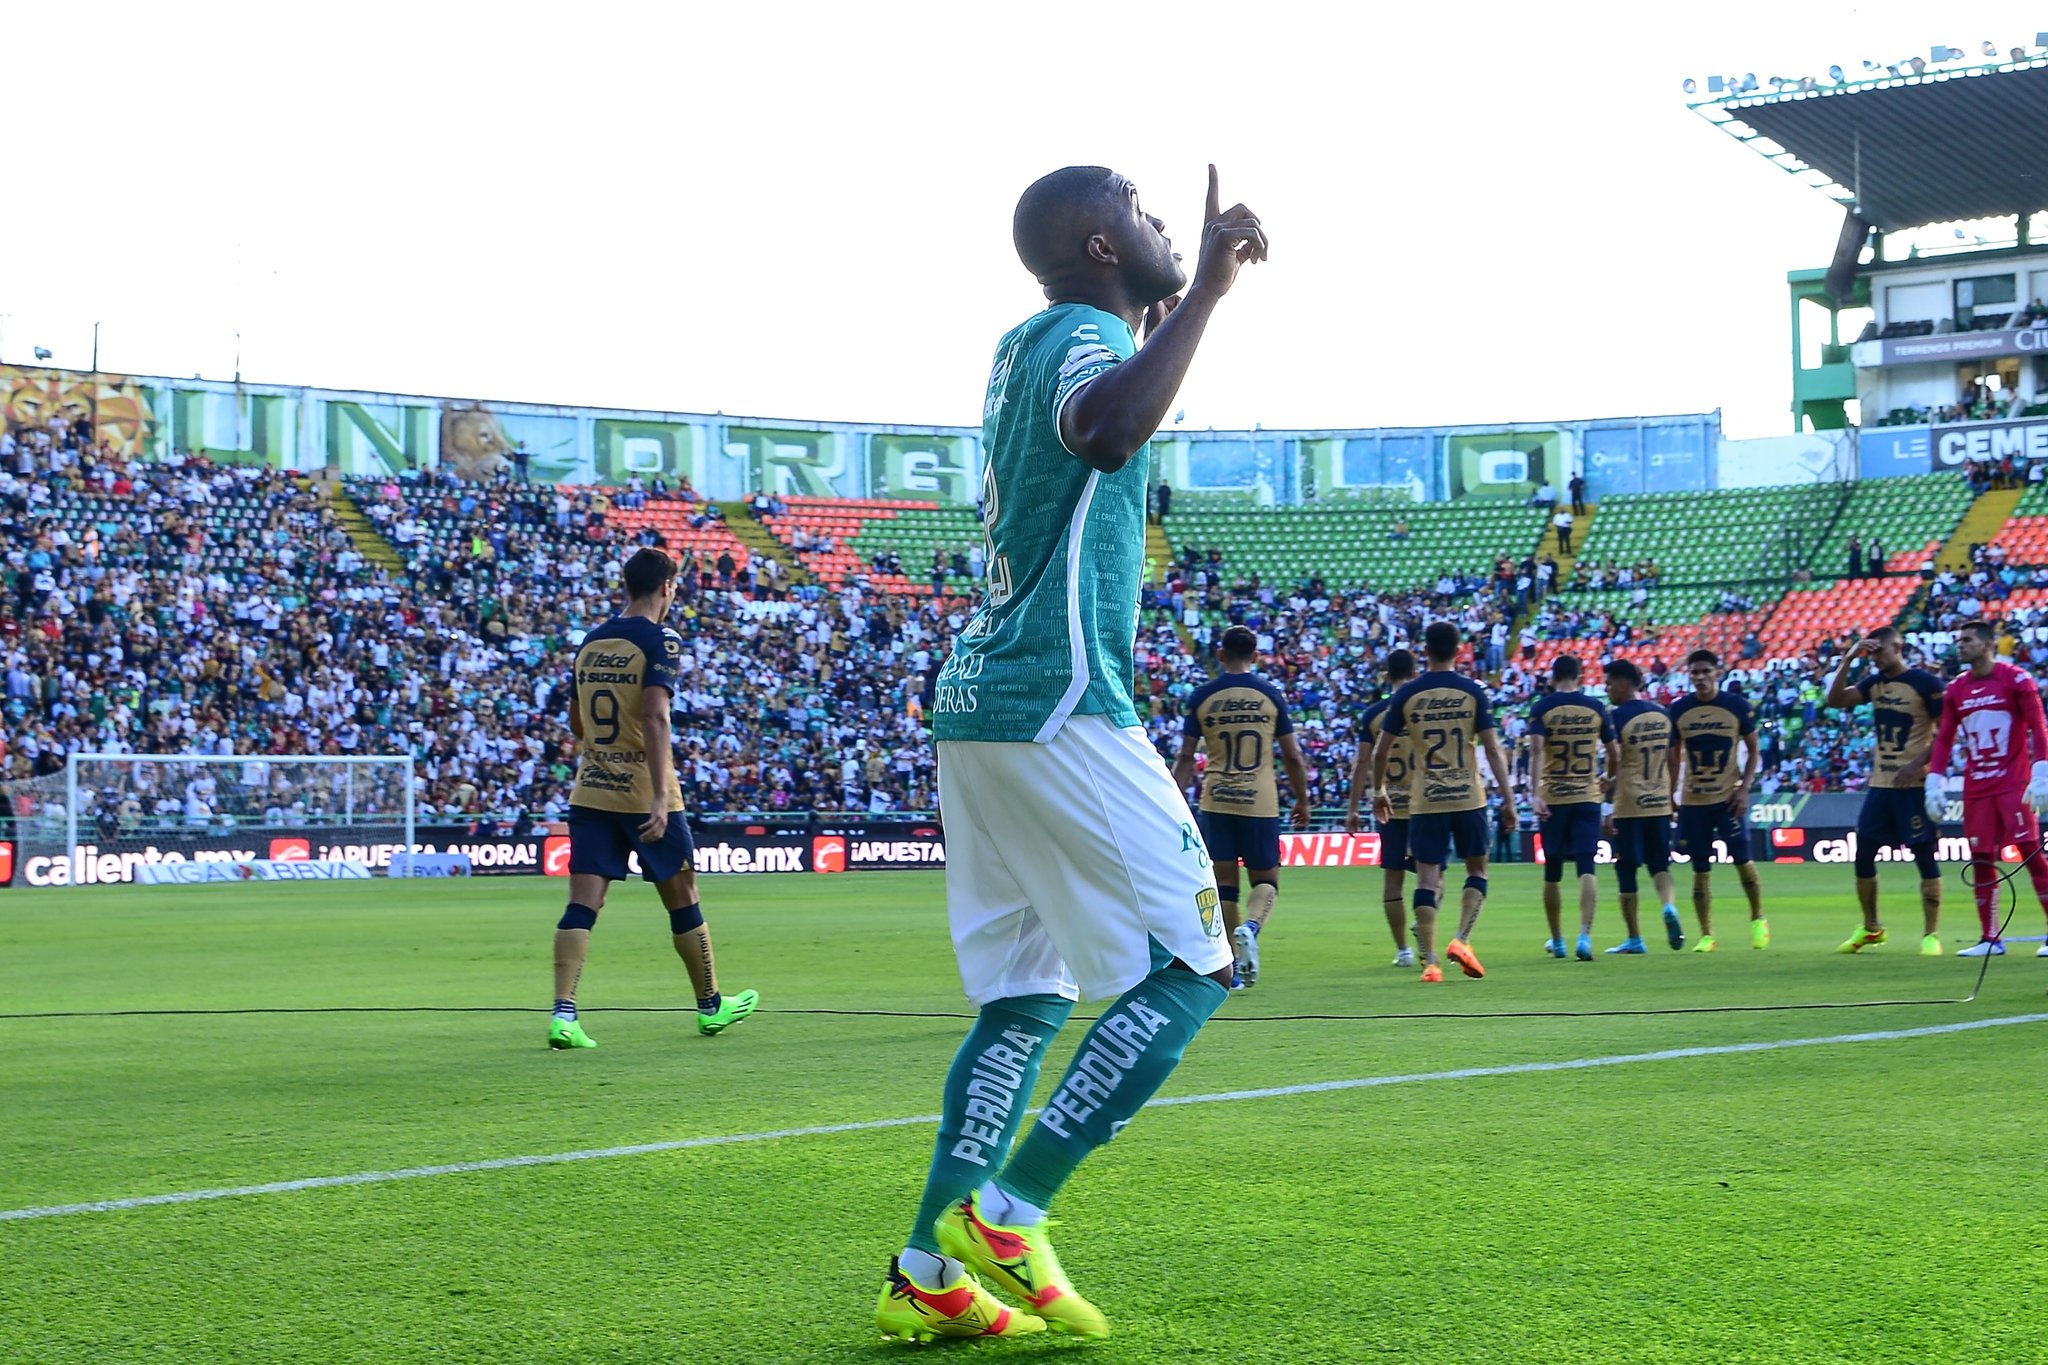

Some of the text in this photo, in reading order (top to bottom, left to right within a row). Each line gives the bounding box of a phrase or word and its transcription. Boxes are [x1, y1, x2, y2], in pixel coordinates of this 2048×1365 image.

[587, 672, 637, 684] SUZUKI
[590, 689, 620, 745] 9
[1219, 730, 1262, 772] 10
[1423, 727, 1464, 770] 21
[1550, 739, 1592, 775] 35
[1640, 744, 1667, 780] 17
[272, 863, 360, 879] BBVA
[1038, 999, 1172, 1140] PERDURA
[951, 1028, 1042, 1168] PERDURA
